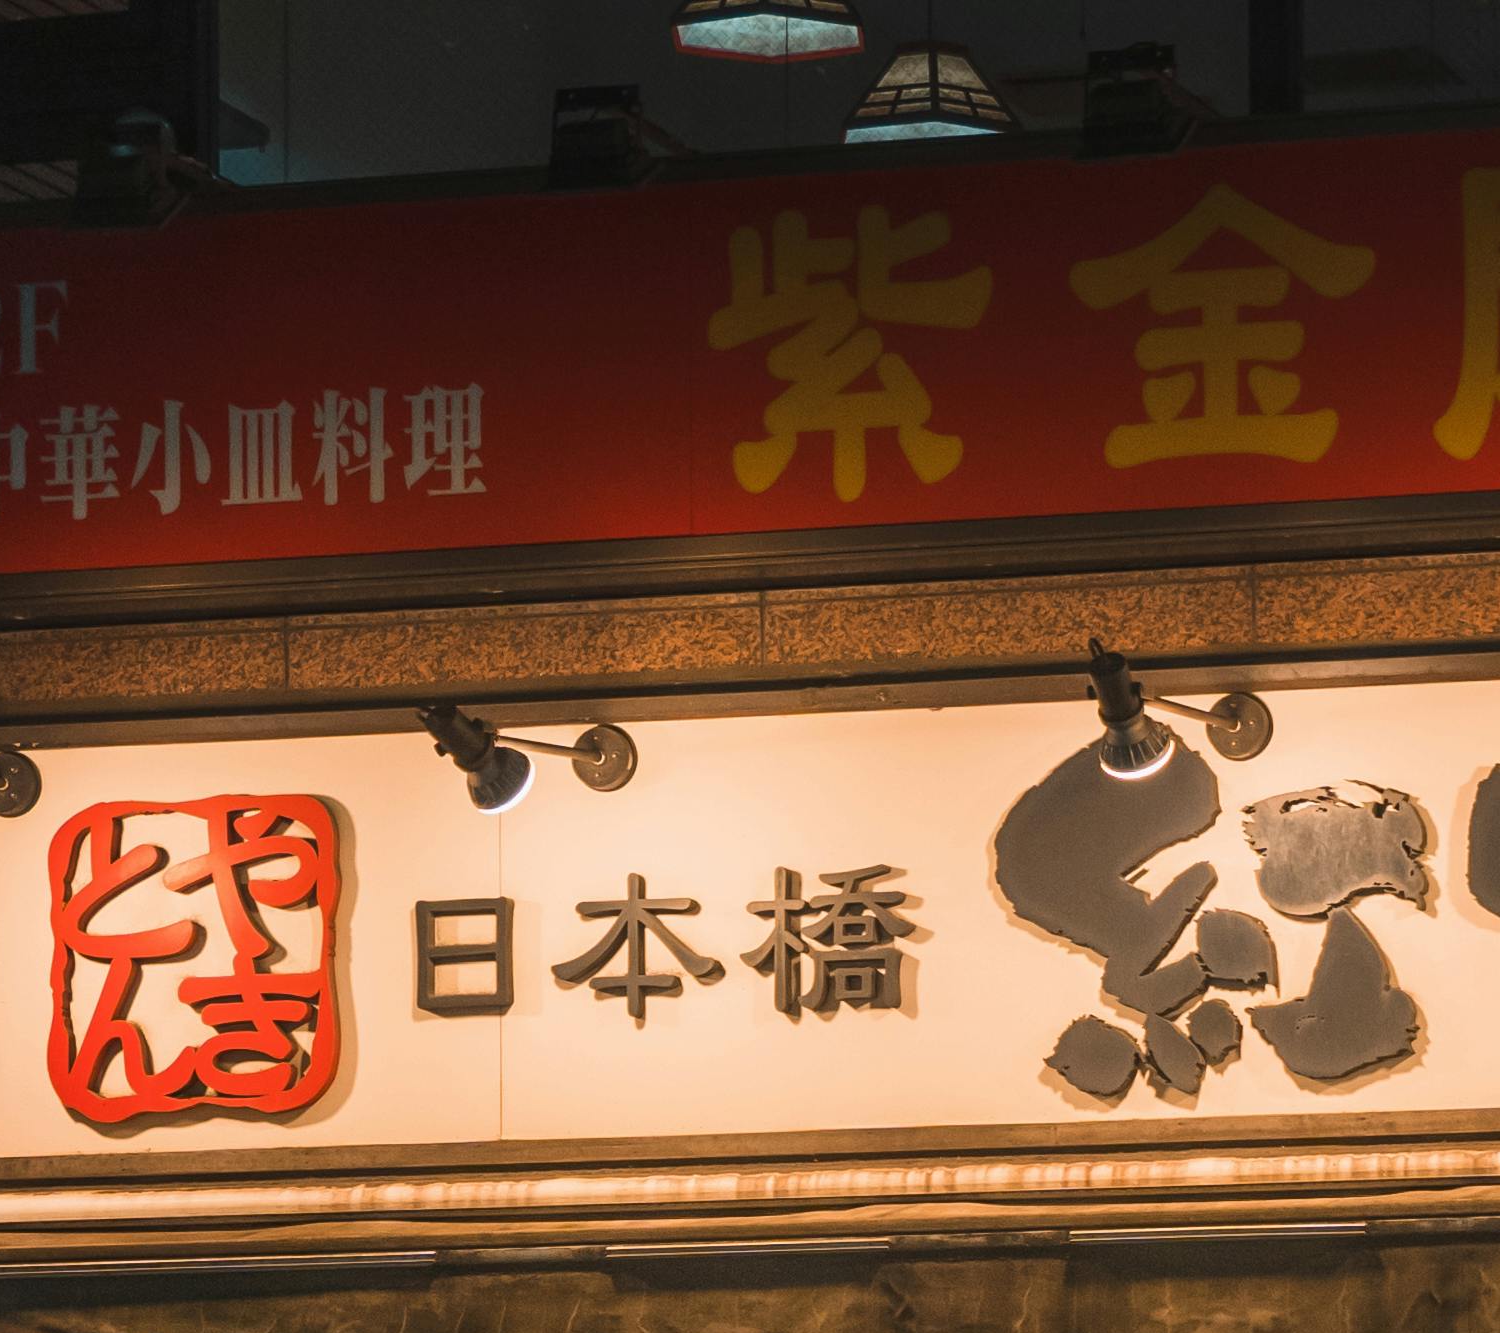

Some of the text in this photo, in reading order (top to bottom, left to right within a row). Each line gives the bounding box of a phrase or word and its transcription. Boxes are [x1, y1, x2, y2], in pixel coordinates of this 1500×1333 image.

[47, 793, 340, 1123] やきとん
[415, 864, 917, 1020] 日本橋
